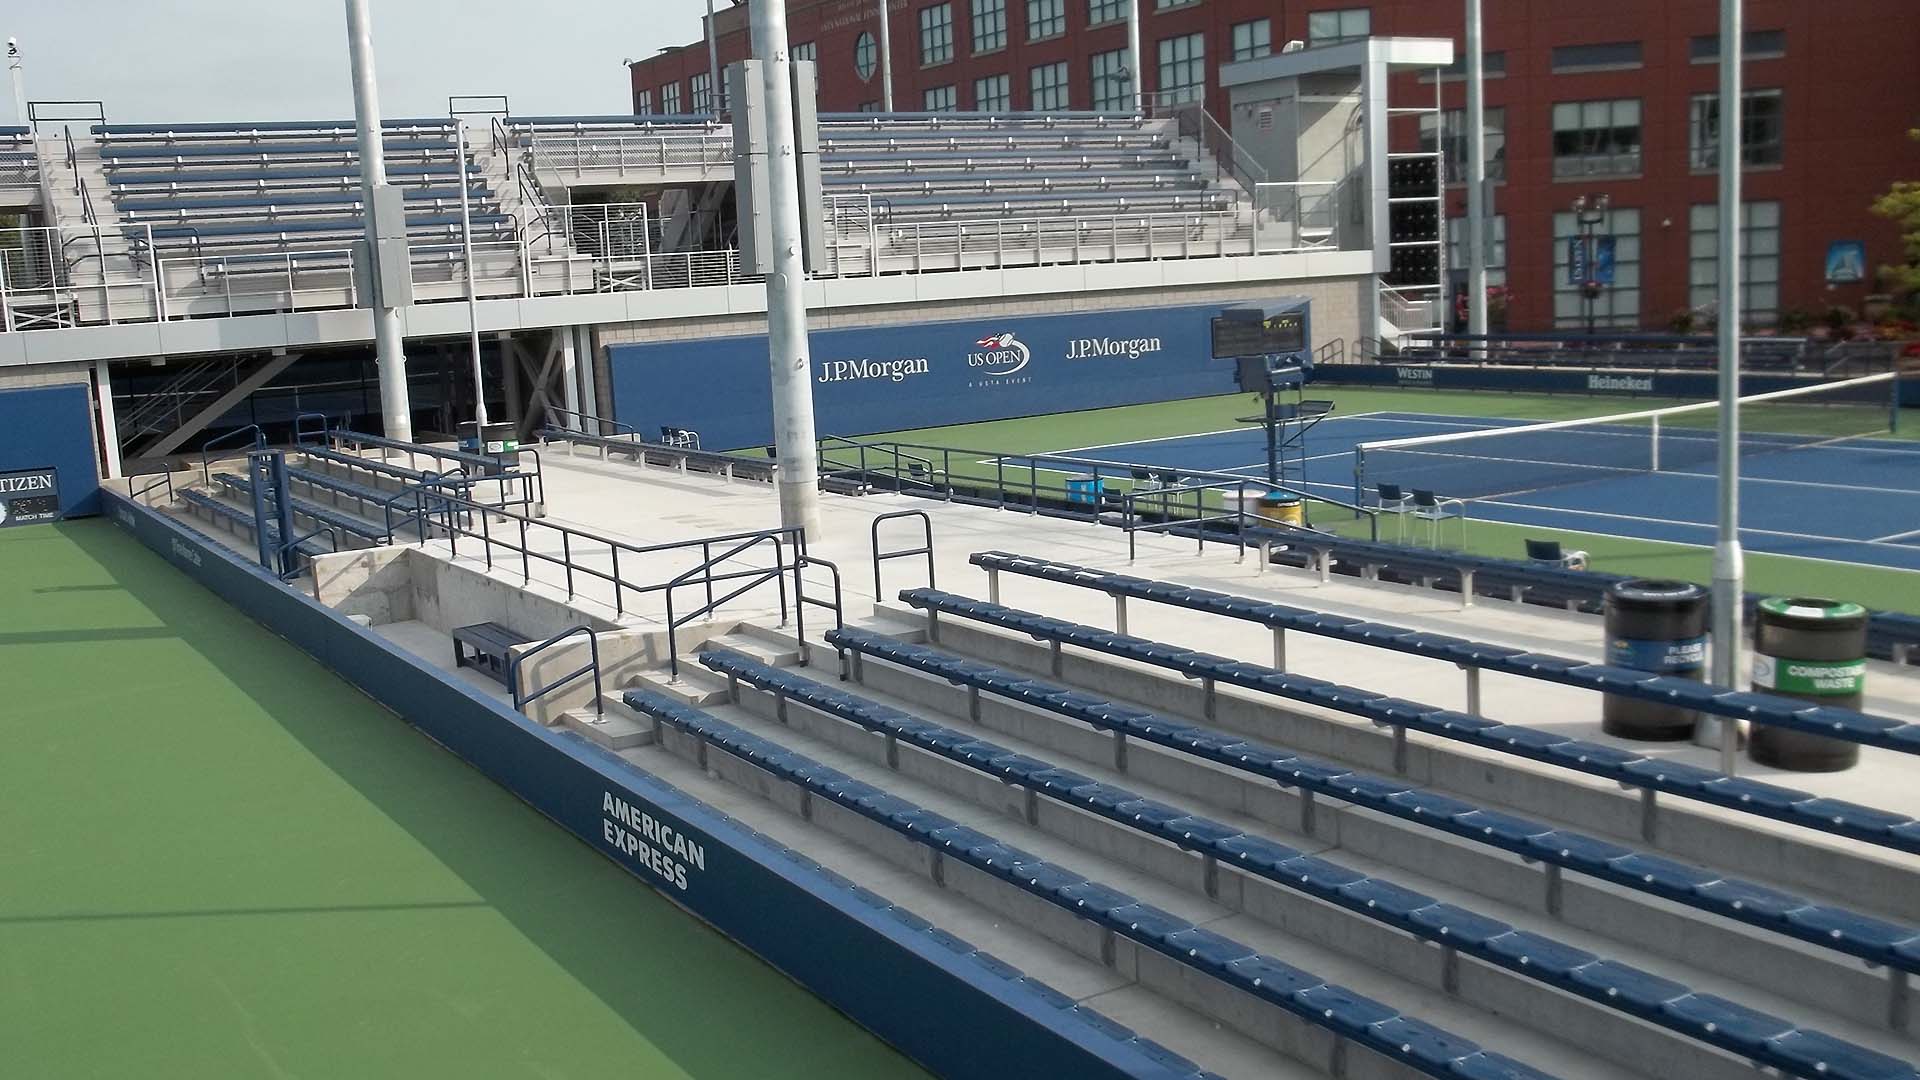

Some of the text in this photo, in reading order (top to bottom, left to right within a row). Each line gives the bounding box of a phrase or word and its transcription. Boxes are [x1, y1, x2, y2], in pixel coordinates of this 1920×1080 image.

[967, 349, 1020, 367] US OPEN
[1066, 337, 1161, 360] J.P.Morgan
[818, 358, 929, 383] J.P.Morgan
[1588, 374, 1653, 391] Heineken
[1813, 676, 1857, 689] WASTE
[603, 791, 705, 871] AMERICAN
[603, 818, 688, 891] EXPRESS
